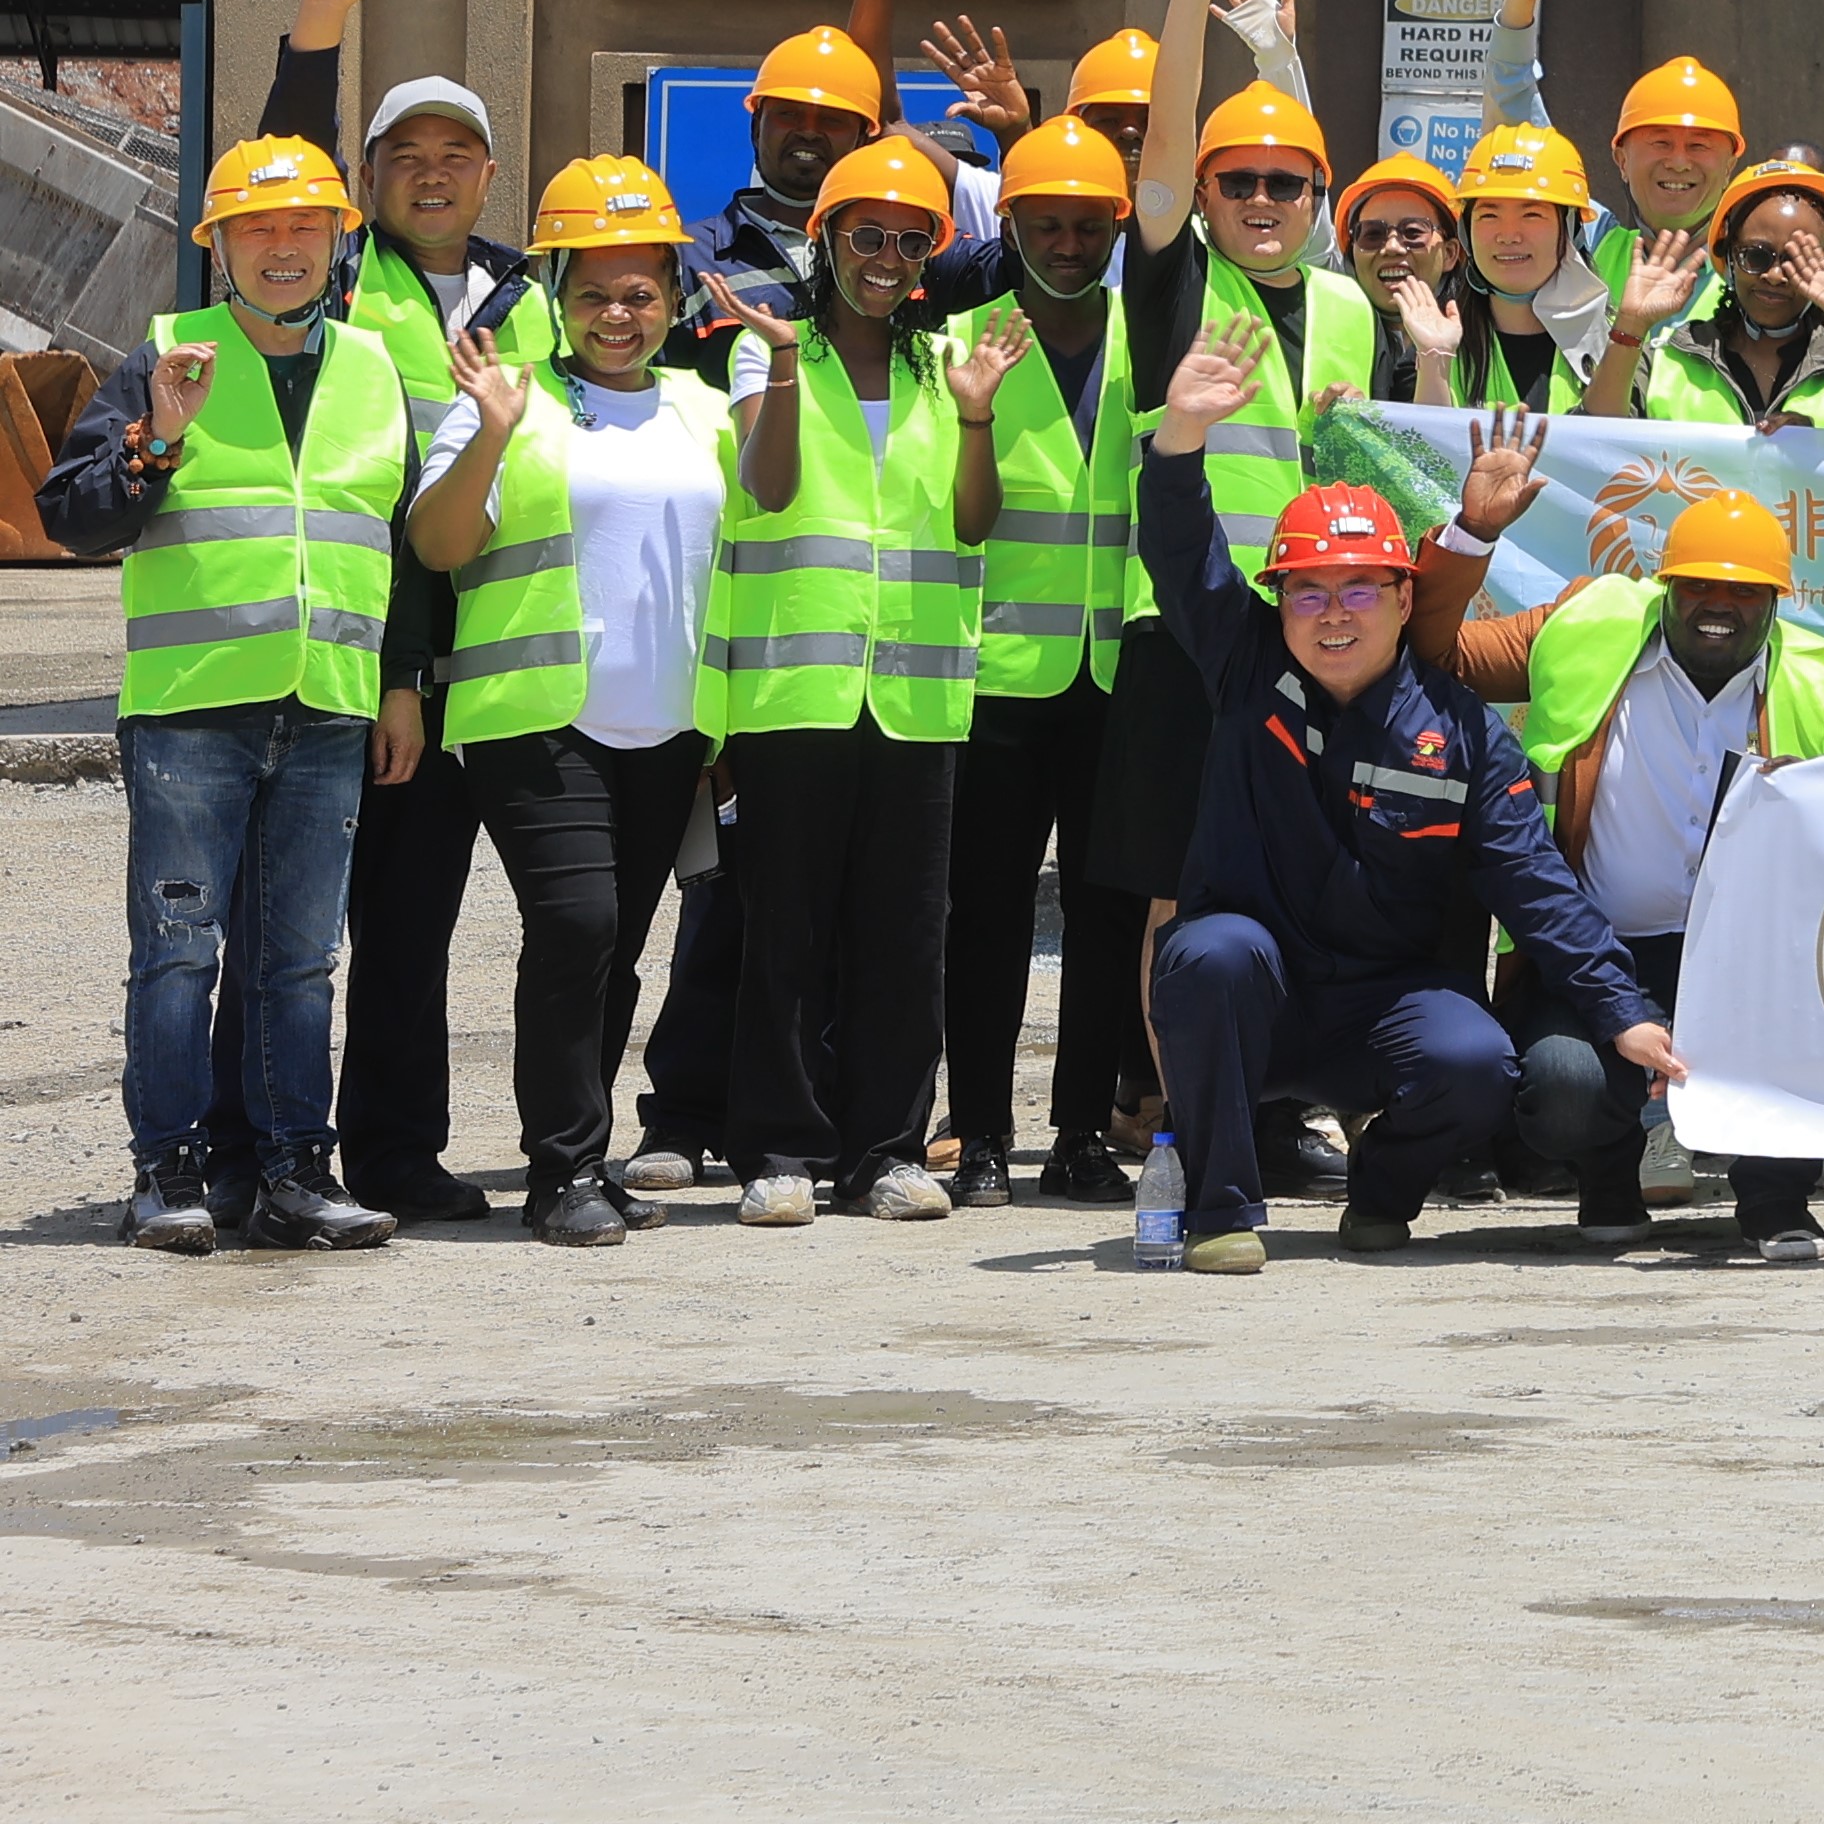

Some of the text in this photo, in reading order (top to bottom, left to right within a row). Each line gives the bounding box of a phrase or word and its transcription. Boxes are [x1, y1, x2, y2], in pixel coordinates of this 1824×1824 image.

[1401, 27, 1461, 42] HARD
[1401, 48, 1489, 63] REQUIR
[1385, 68, 1478, 80] BEYOND THIS
[1434, 122, 1459, 139] No
[1432, 144, 1457, 161] No
